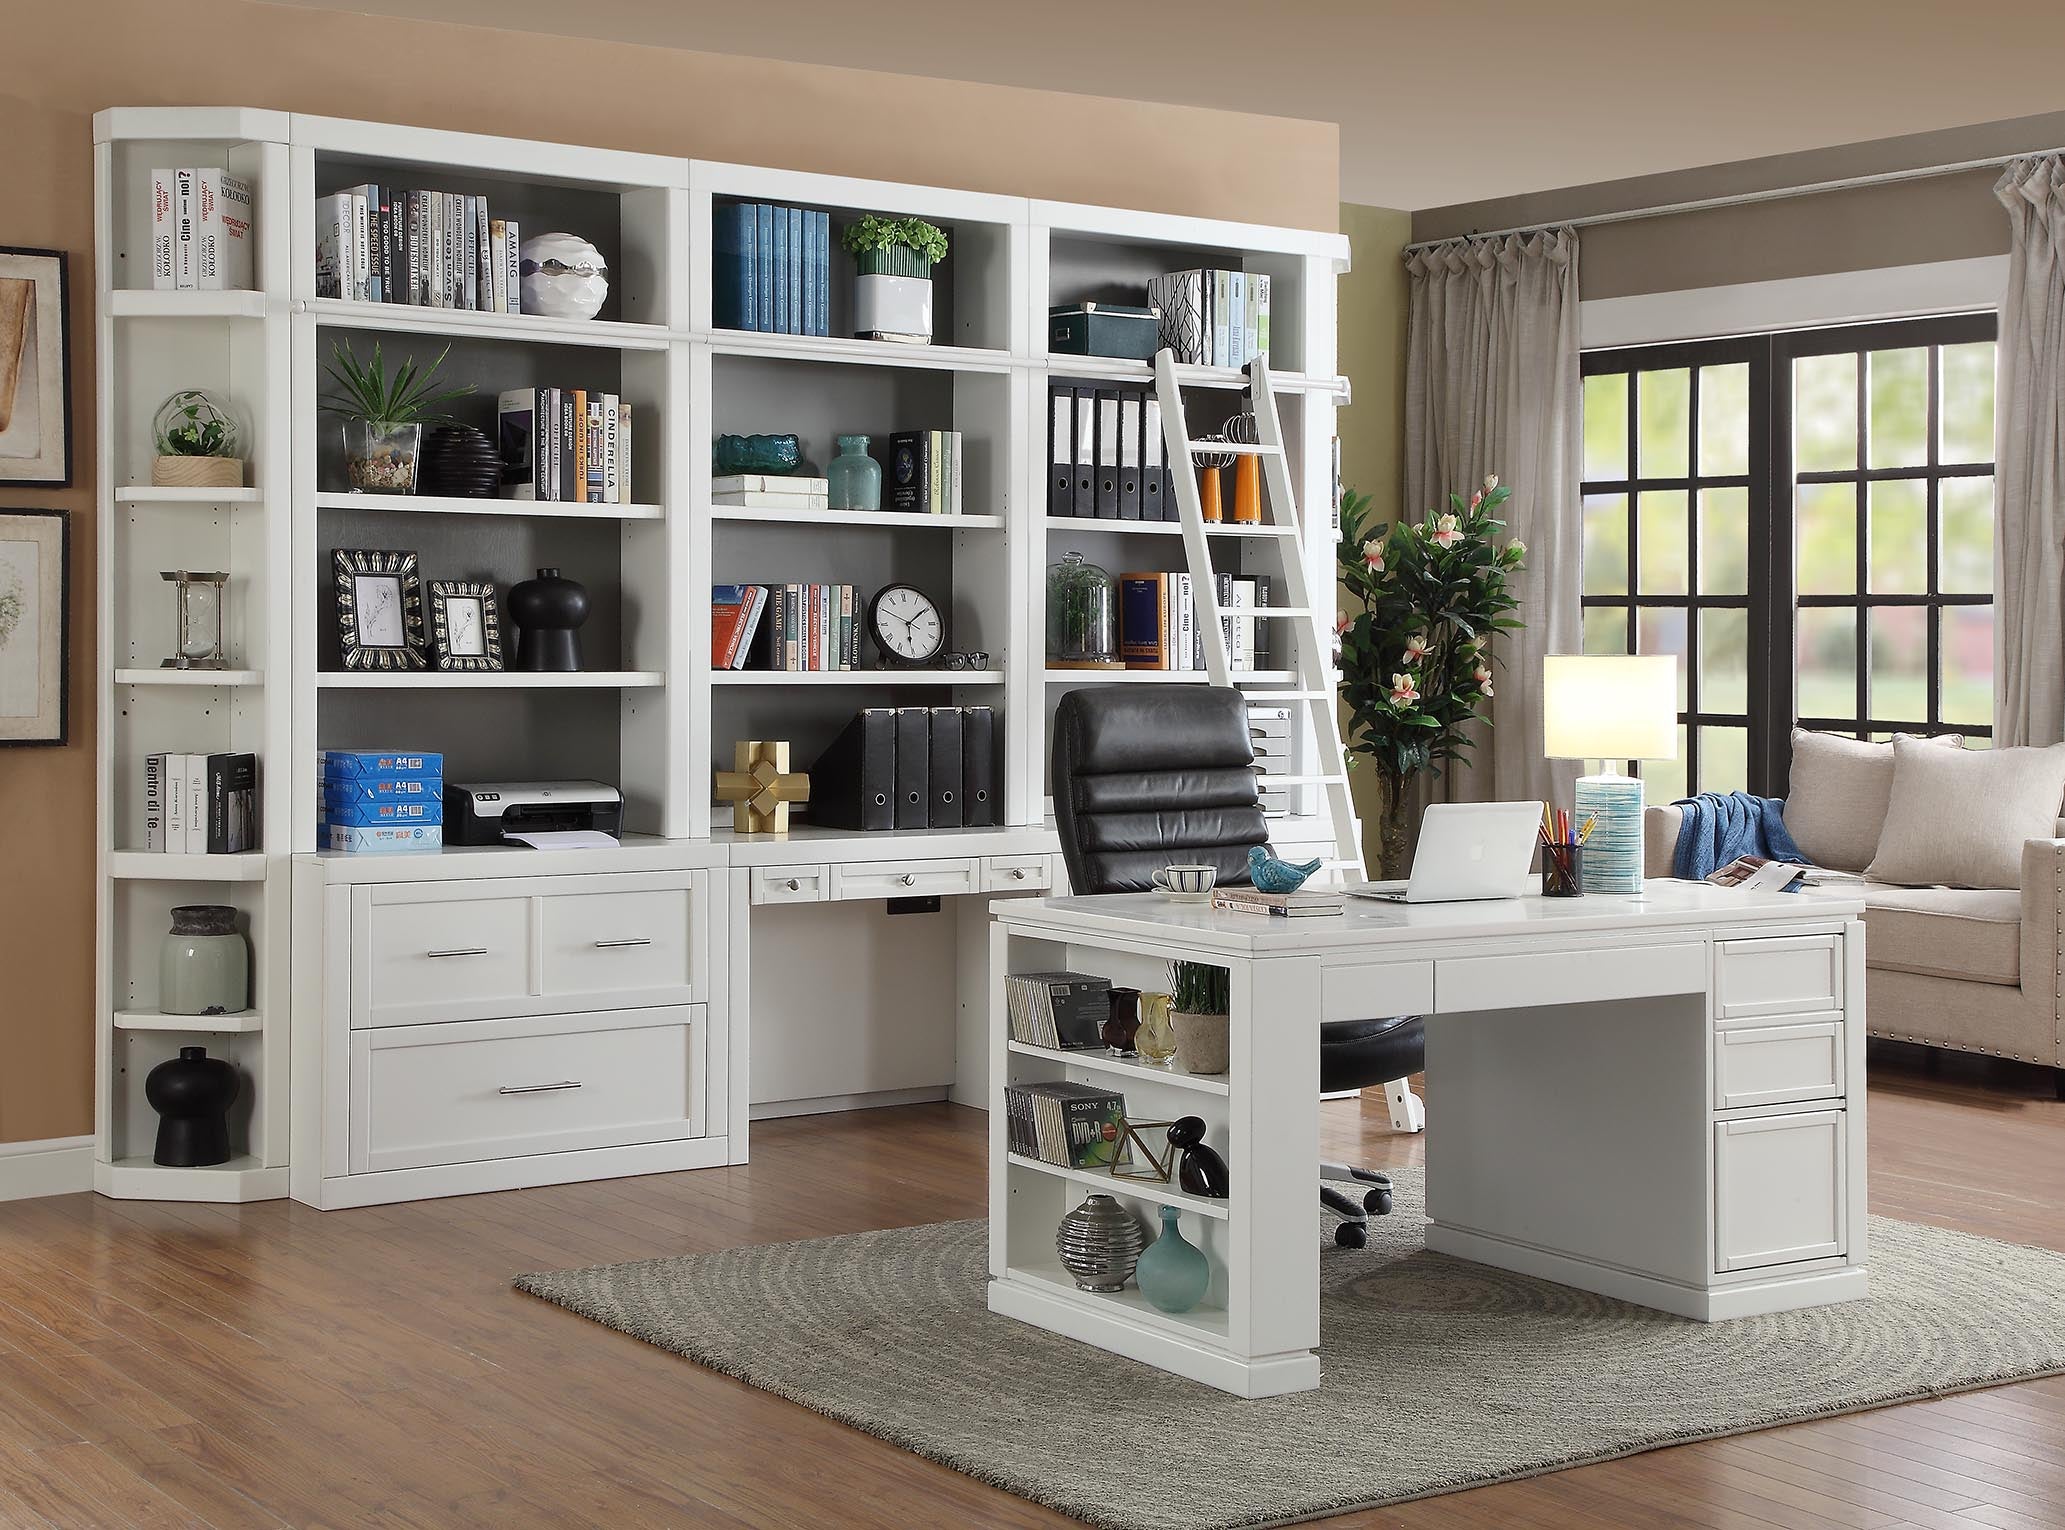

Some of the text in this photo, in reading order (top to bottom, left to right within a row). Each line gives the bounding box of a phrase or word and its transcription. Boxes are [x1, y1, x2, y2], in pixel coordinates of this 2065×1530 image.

[180, 218, 191, 241] Cine
[370, 214, 380, 274] THE SPEED ISSUE
[509, 232, 518, 278] AMANG
[384, 256, 390, 265] TO
[384, 266, 390, 274] BE
[410, 235, 419, 290] BONESHAKER
[579, 445, 584, 454] IN
[147, 758, 160, 828] Dentro di te
[1070, 1102, 1098, 1112] SONY
[1072, 1120, 1102, 1144] DVD+R
